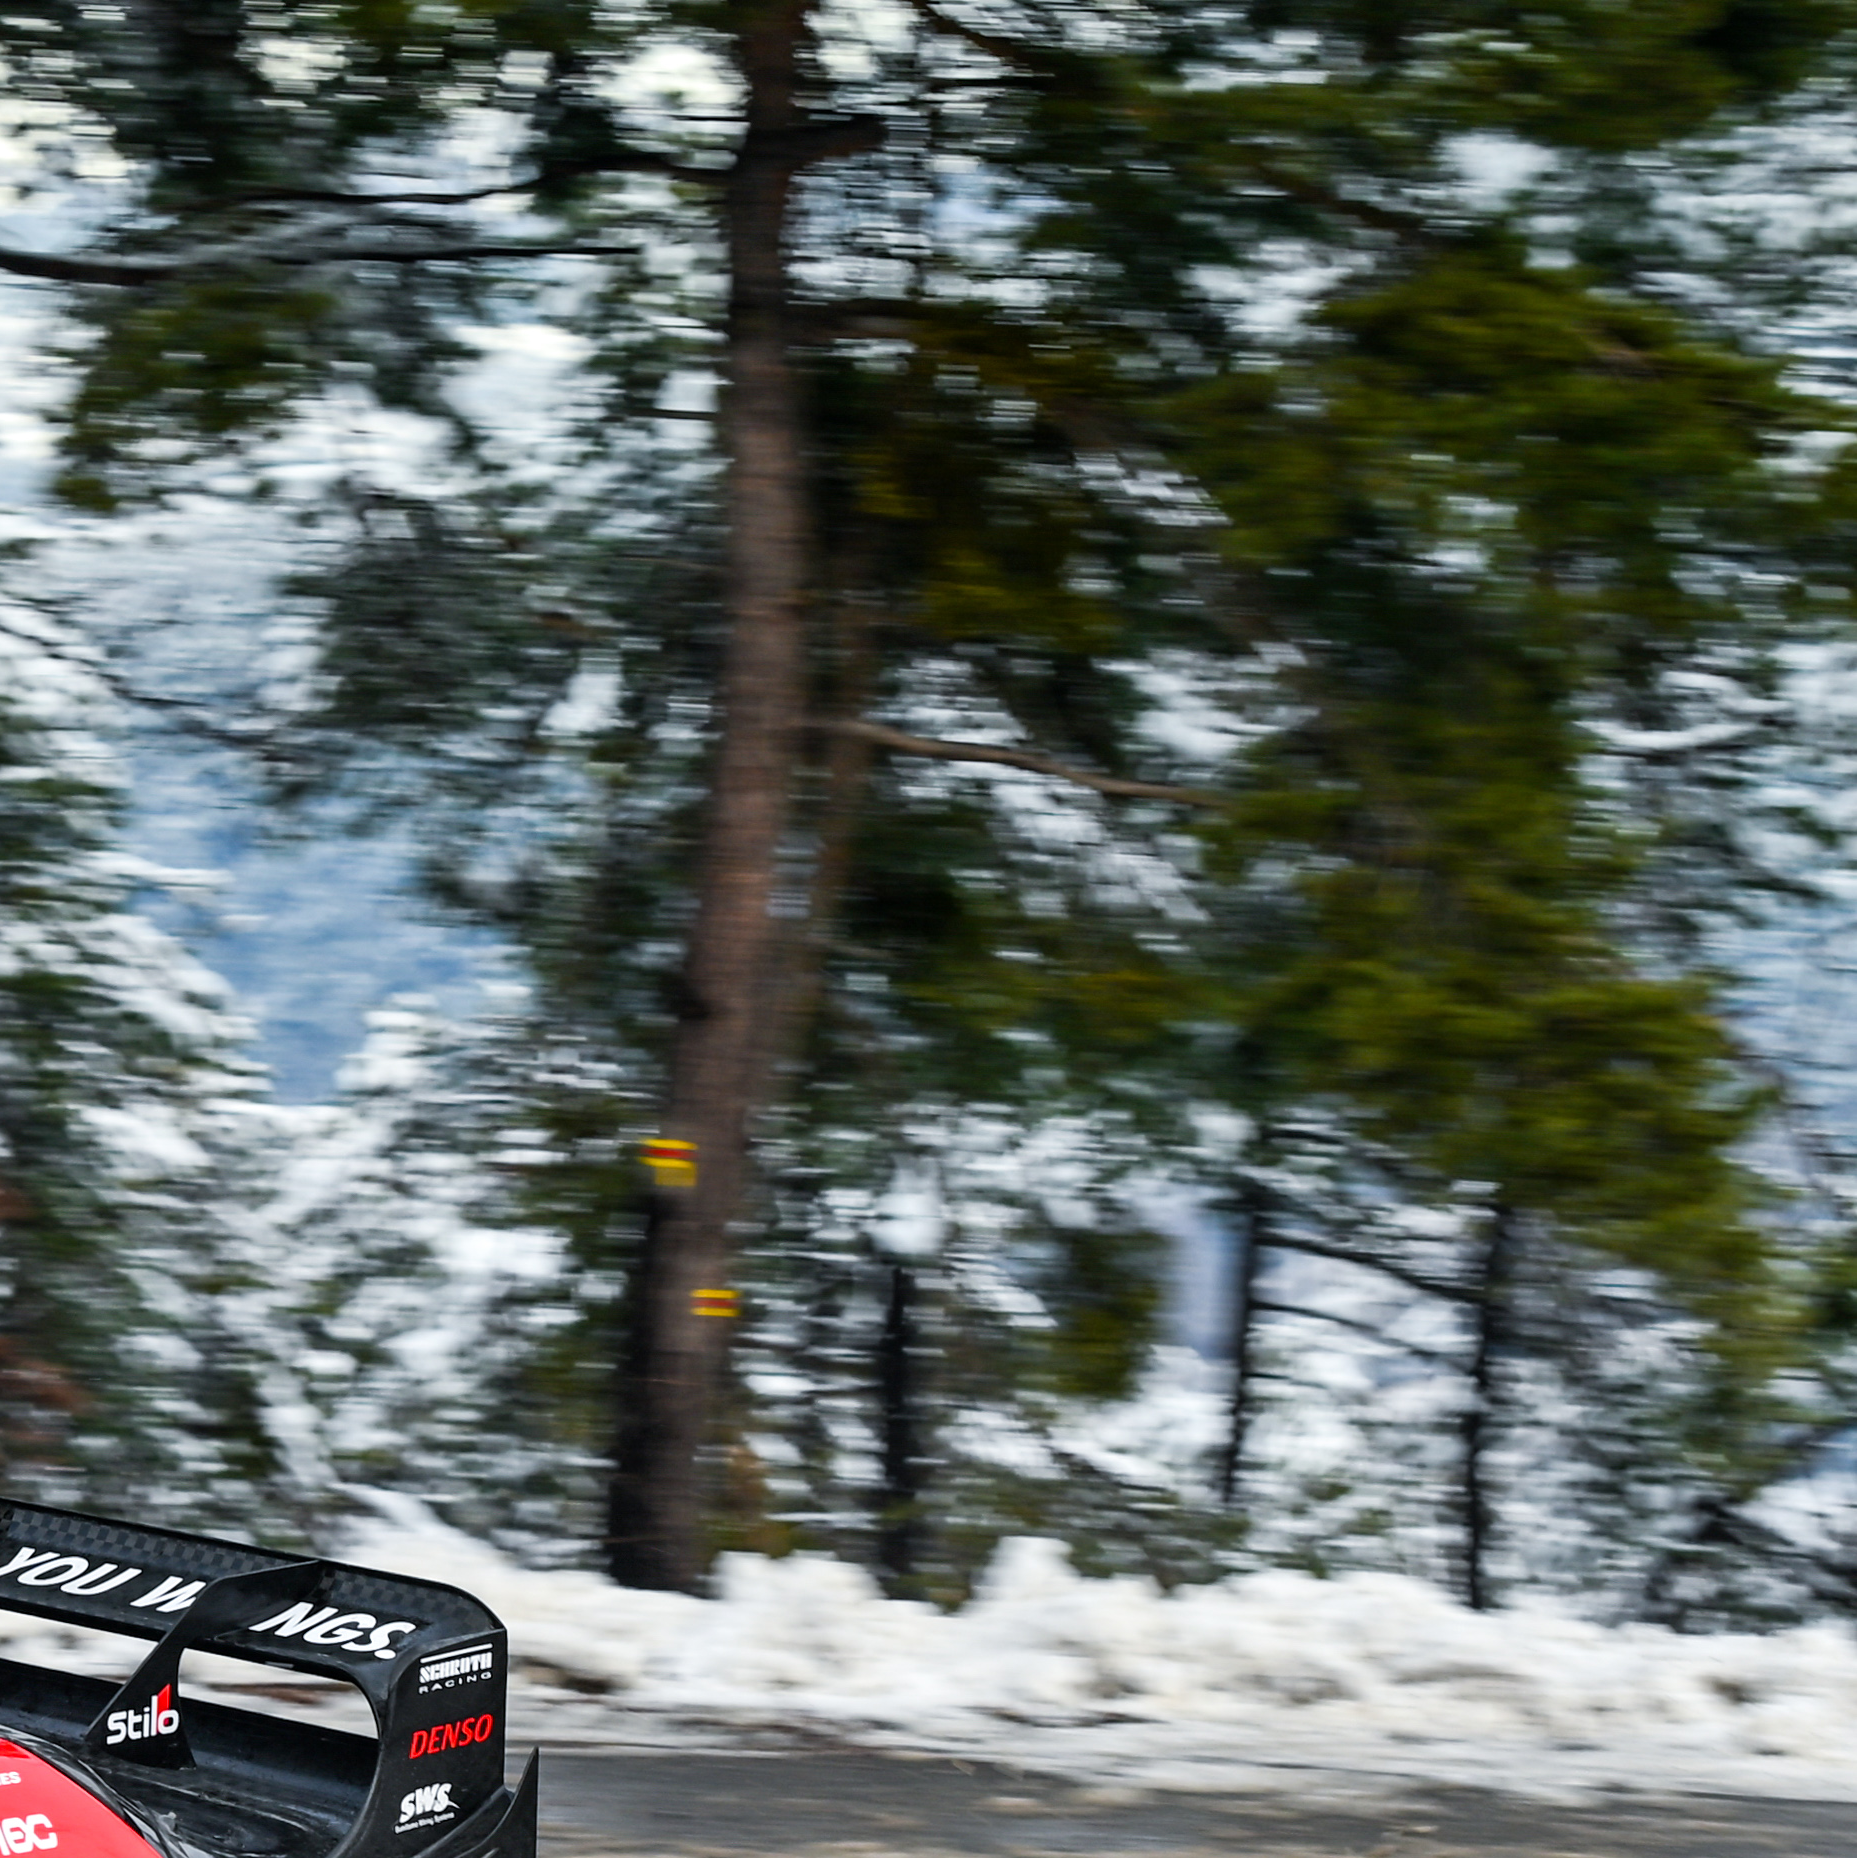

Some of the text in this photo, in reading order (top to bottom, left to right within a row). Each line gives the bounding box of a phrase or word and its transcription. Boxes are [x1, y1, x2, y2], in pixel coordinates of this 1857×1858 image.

[130, 1576, 417, 1660] WNGS.
[418, 1671, 493, 1694] RACING
[419, 1651, 493, 1684] SCHROTH
[106, 1683, 179, 1746] Stilo
[409, 1713, 494, 1760] DENSO
[399, 1783, 456, 1824] SWS
